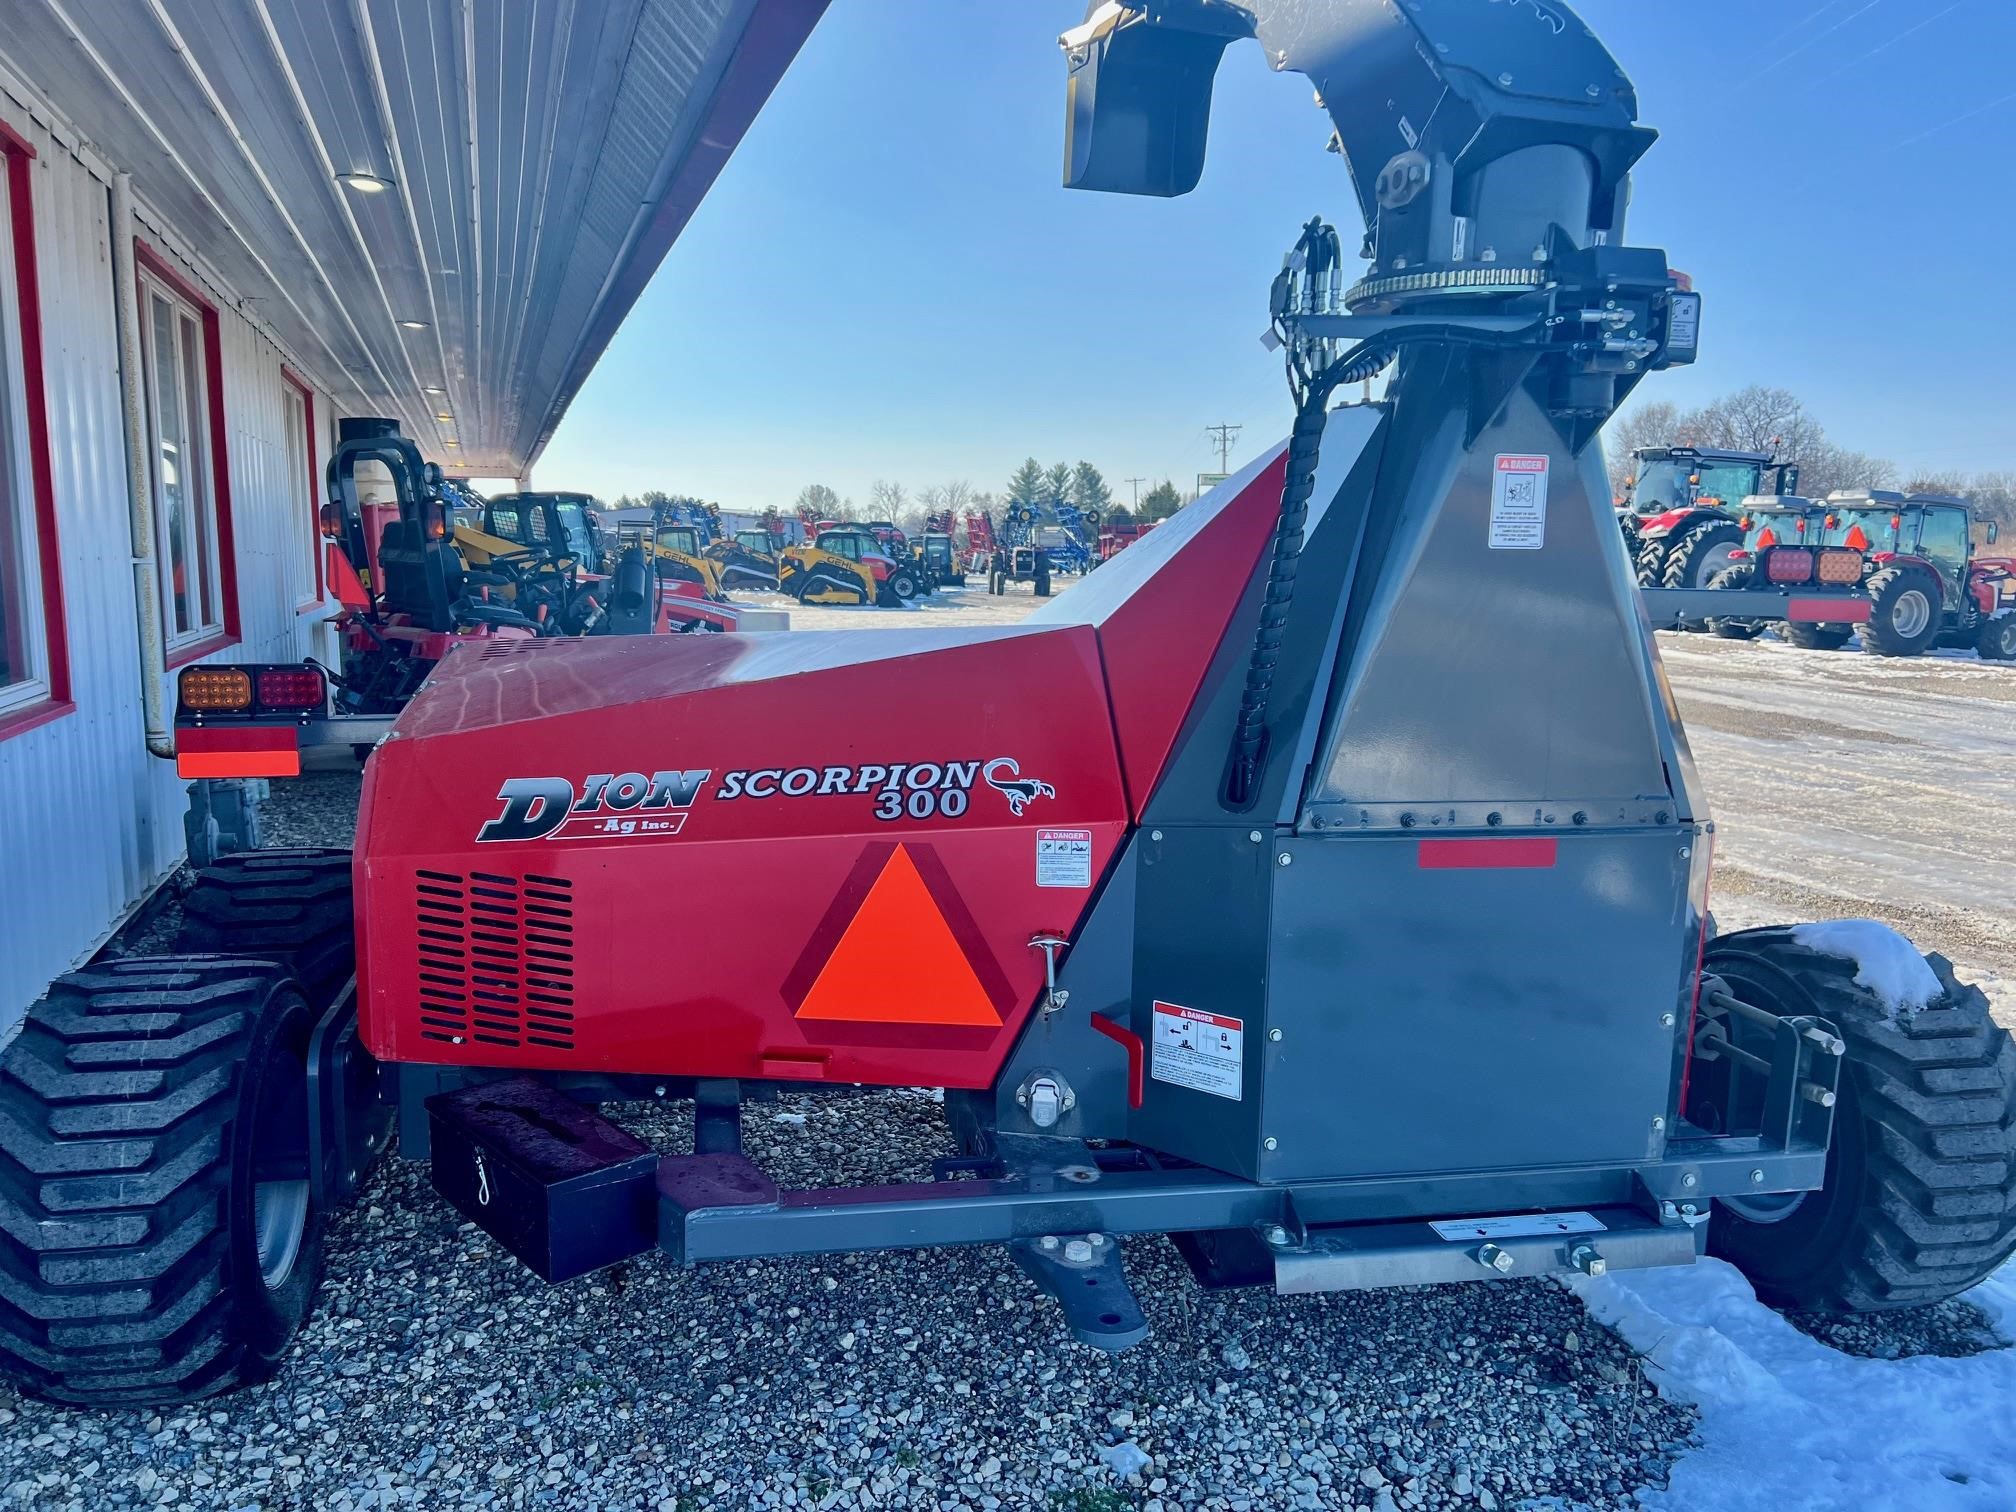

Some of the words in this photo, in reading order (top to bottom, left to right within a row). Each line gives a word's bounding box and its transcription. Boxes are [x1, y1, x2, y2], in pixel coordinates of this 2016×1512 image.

[1510, 460, 1542, 470] DANGER
[663, 551, 690, 565] GEHL
[827, 556, 856, 570] GEHL
[715, 760, 981, 799] SCORPION
[475, 769, 712, 842] DION
[874, 788, 968, 820] 300
[641, 820, 675, 831] Inc.
[1053, 832, 1084, 840] DANGER
[1187, 1012, 1214, 1024] DANGER
